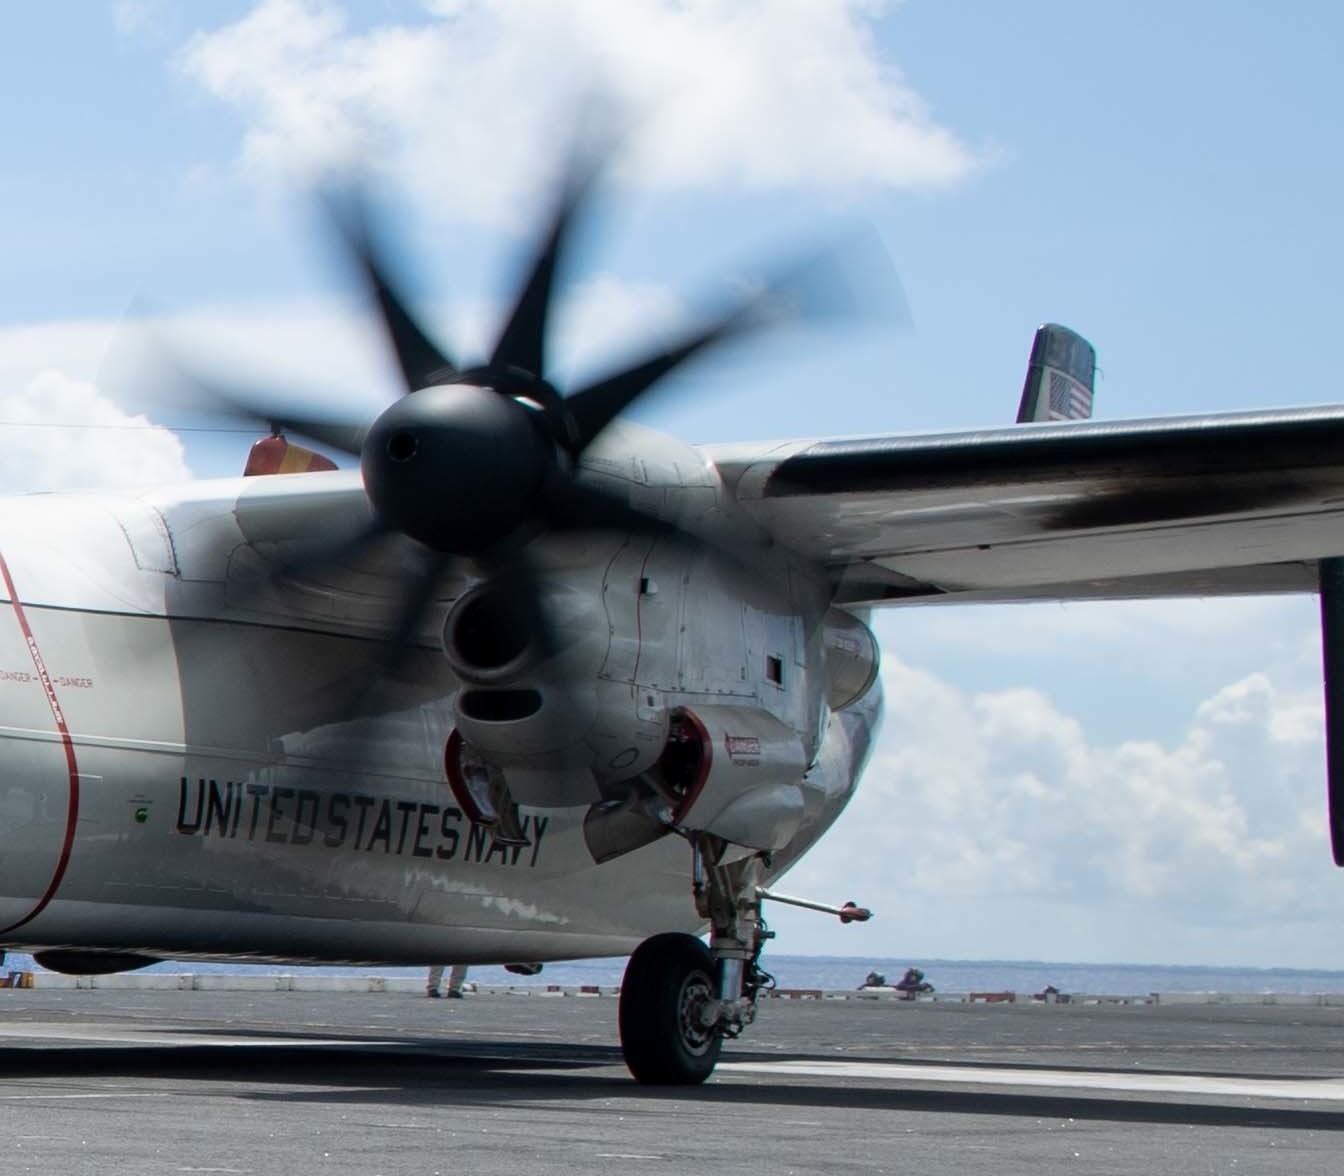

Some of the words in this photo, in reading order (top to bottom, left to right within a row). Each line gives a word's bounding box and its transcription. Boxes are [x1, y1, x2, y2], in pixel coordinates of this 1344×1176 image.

[59, 676, 94, 688] DANGER
[176, 777, 317, 846] UNITED
[323, 794, 462, 861] STATES
